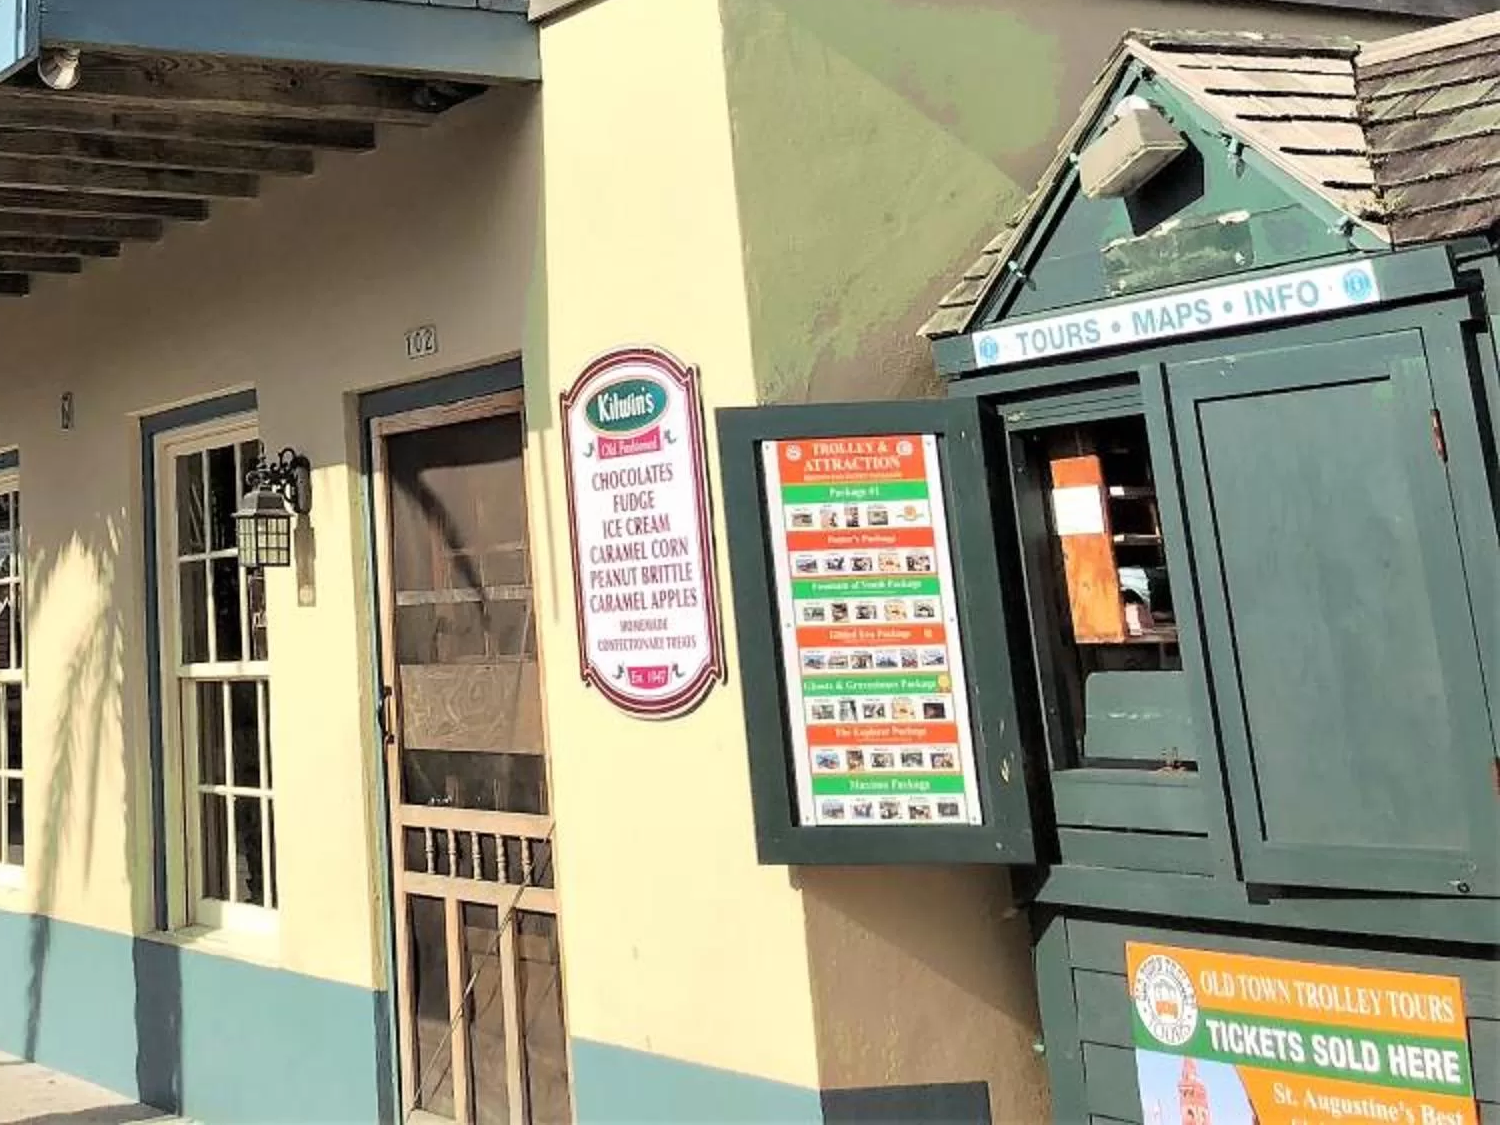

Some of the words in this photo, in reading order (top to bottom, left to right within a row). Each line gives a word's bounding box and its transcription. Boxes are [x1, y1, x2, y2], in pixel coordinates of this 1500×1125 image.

[1015, 318, 1102, 356] TOURS
[1132, 298, 1212, 337] MAPS
[1245, 279, 1320, 317] INFO
[597, 386, 656, 423] Kilwin's
[812, 442, 874, 456] TROLLEY
[877, 440, 889, 454] &
[591, 462, 674, 492] CHOCOLATES
[804, 455, 902, 472] ATTRACTION
[613, 490, 655, 513] FUDGE
[602, 518, 623, 540] ICE
[626, 513, 671, 535] CREAM
[589, 541, 648, 565] CARAMEL
[651, 536, 689, 559] CORN
[590, 566, 638, 589] PEANUT
[642, 561, 693, 585] BRITTLE
[589, 590, 648, 614] CARAMEL
[651, 587, 698, 610] APPLES
[1199, 969, 1235, 998] OLD
[1237, 973, 1292, 1004] TOWN
[1291, 978, 1385, 1017] TROLLEY
[1384, 989, 1455, 1023] TOURS
[1205, 1018, 1305, 1063] TICKETS
[1311, 1033, 1381, 1073] SOLD
[1387, 1043, 1462, 1084] HERE
[1272, 1082, 1298, 1105] St.
[1303, 1088, 1416, 1124] Augustine's
[1420, 1103, 1464, 1125] Best
